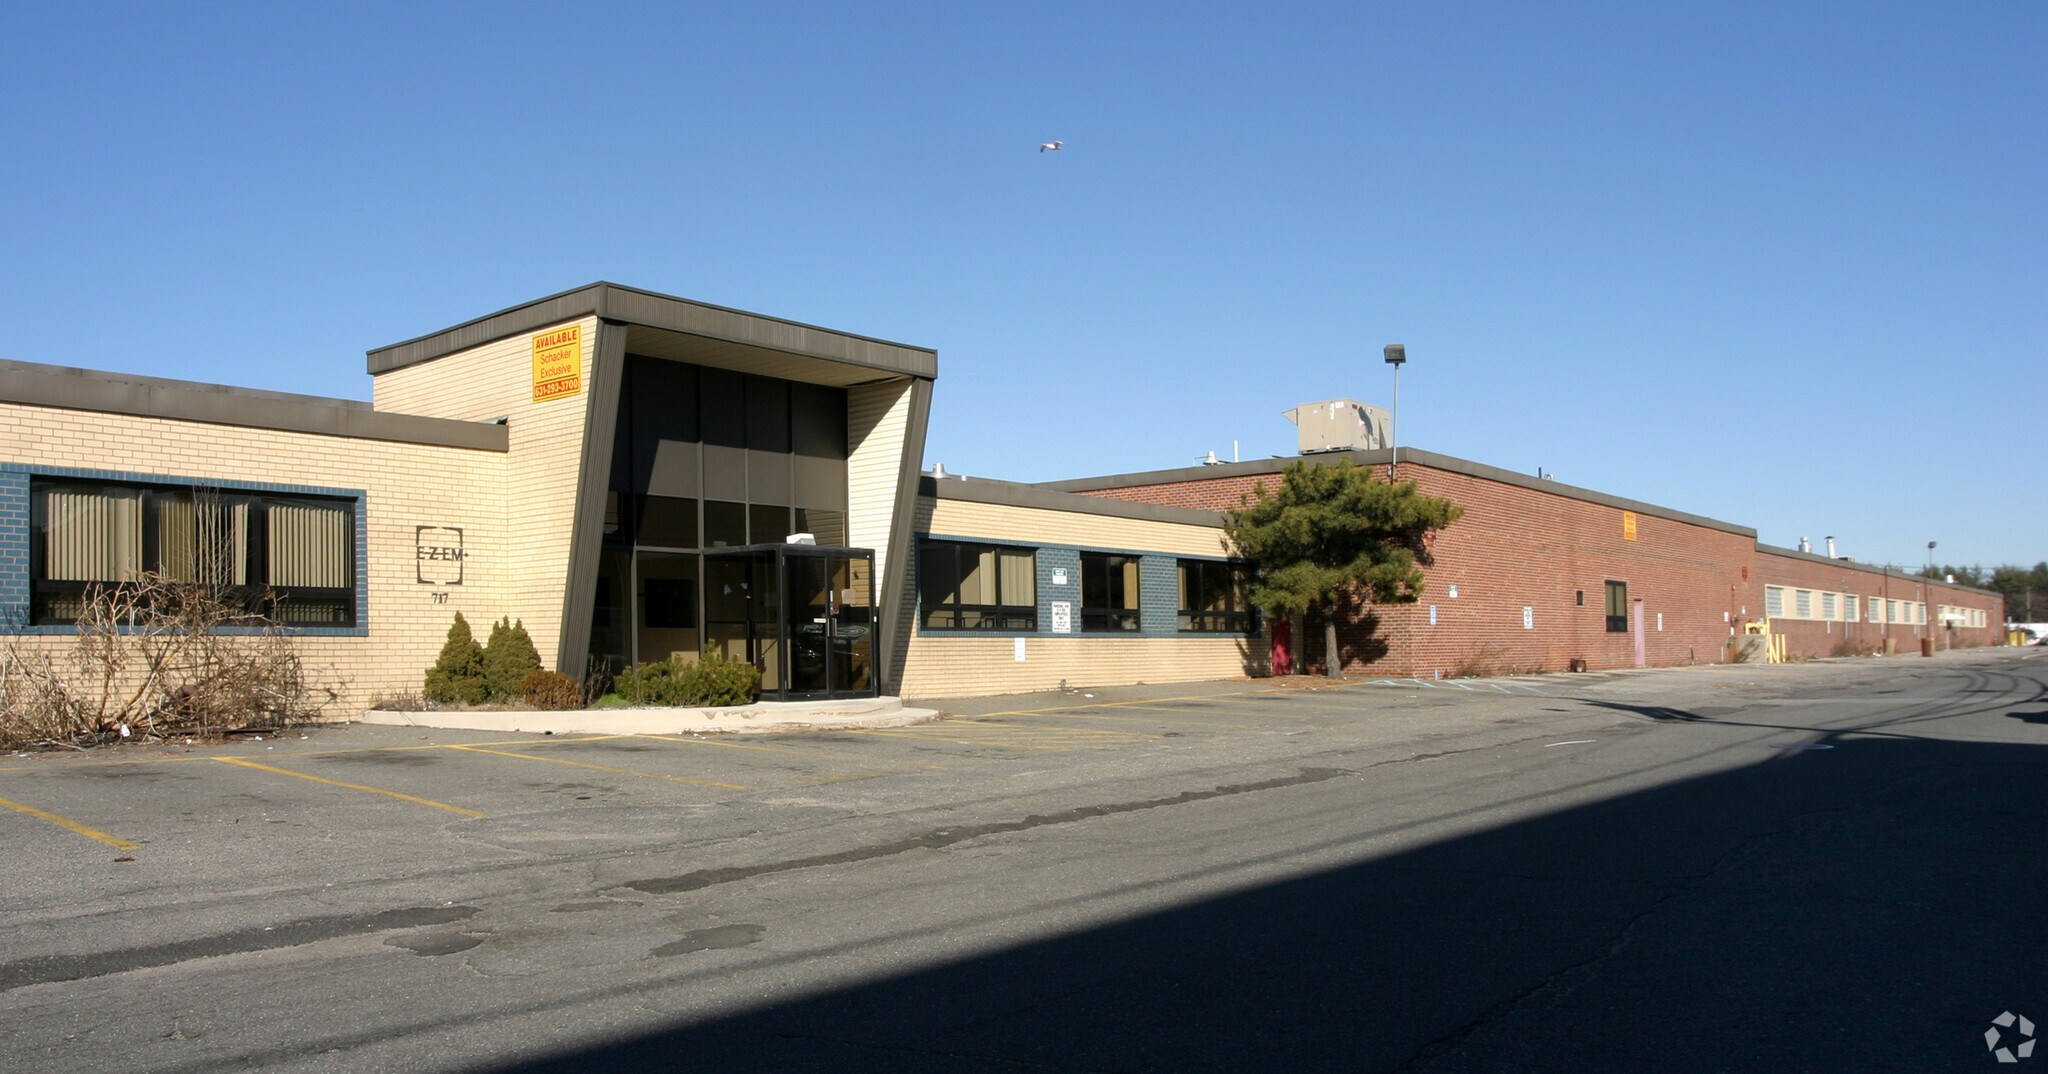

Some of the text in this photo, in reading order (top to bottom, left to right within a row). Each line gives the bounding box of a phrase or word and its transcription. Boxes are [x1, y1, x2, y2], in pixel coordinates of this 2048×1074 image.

[536, 330, 577, 349] AVAILABLE
[540, 350, 572, 365] Schacker
[540, 364, 572, 379] Exclusive
[431, 593, 449, 604] 717
